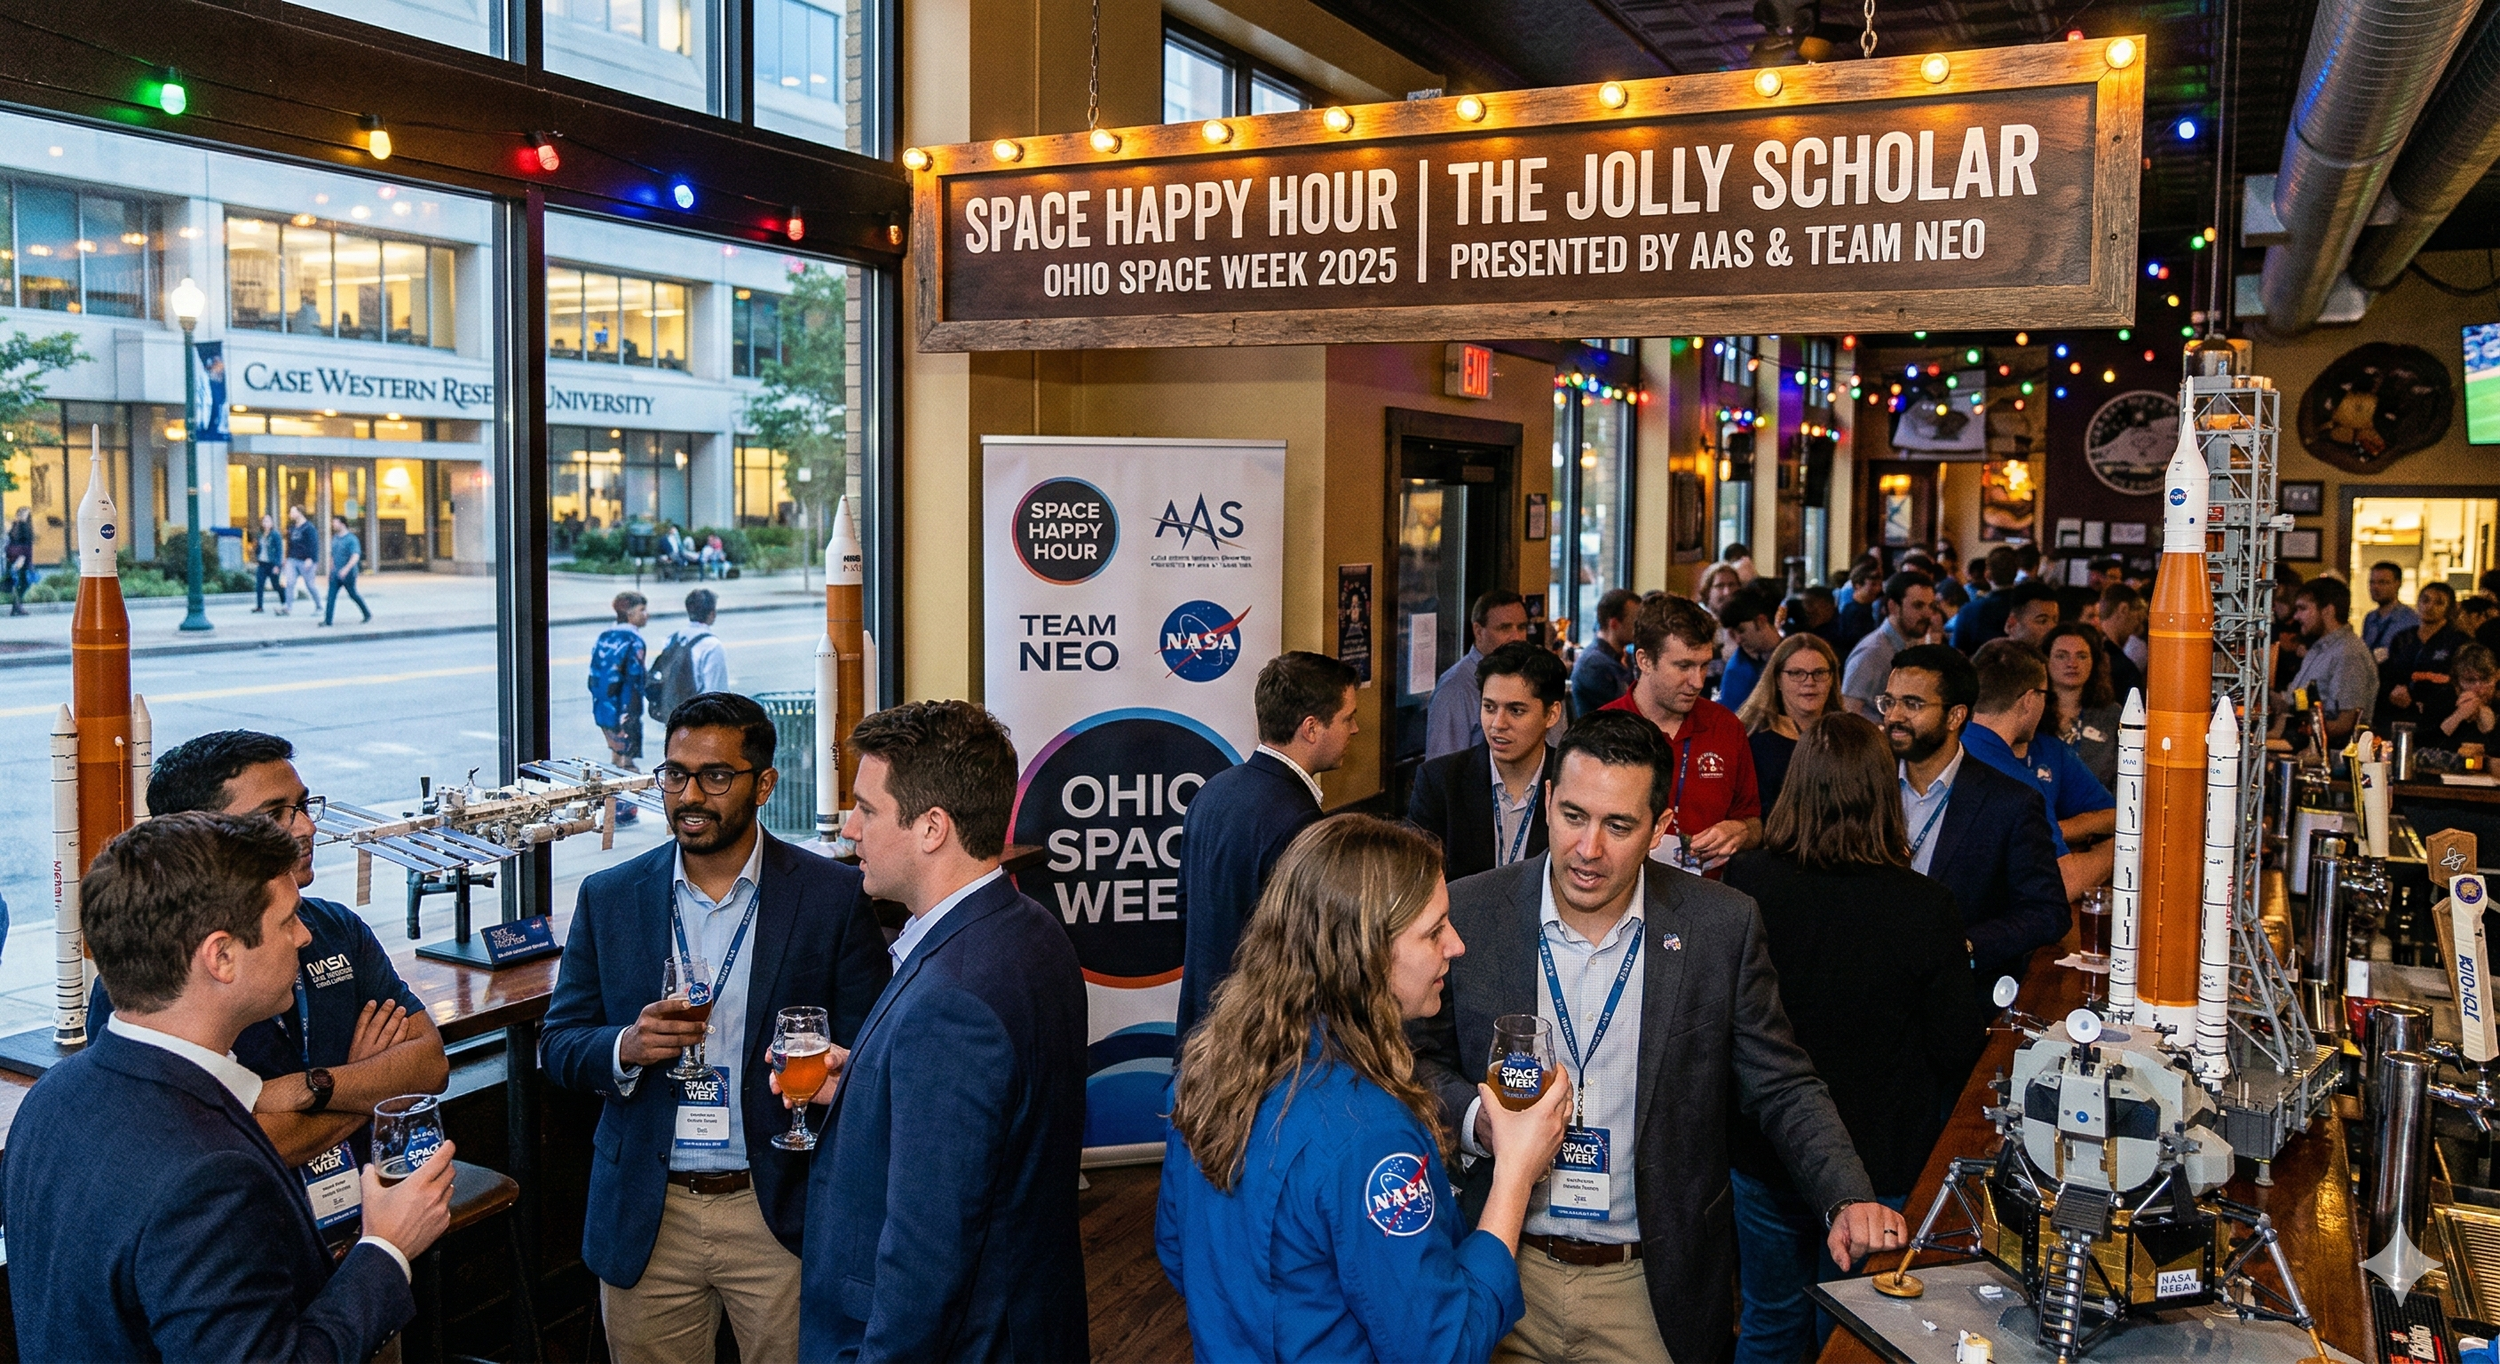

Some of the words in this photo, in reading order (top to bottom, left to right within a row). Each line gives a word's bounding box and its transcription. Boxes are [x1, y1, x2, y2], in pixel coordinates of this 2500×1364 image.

[1447, 157, 1547, 225] THE
[1567, 144, 1733, 220] JOLLY
[1751, 123, 2039, 211] SCHOLAR
[965, 190, 1091, 254] SPACE
[1107, 178, 1253, 246] HAPPY
[1269, 168, 1398, 237] HOUR
[1451, 235, 1628, 280] PRESENTED
[1639, 232, 1681, 273] BY
[1690, 229, 1755, 270] AAS
[1766, 228, 1793, 267] &
[1805, 222, 1901, 265] TEAM
[1914, 218, 1986, 261] NEO
[1044, 262, 1109, 297] OHIO
[1119, 256, 1211, 294] SPACE
[1220, 251, 1308, 289] WEEK
[1318, 247, 1397, 286] 2025
[443, 377, 494, 408] RESE
[1030, 502, 1100, 519] SPACE
[1154, 491, 1244, 551] AAS
[1028, 522, 1103, 539] HAPPY
[1034, 543, 1098, 560] HOUR
[1019, 614, 1116, 636] TEAM
[1166, 632, 1236, 651] NASA
[1019, 640, 1120, 672] NEO
[1047, 825, 1184, 873] SPAC
[1053, 878, 1178, 924] WEE
[306, 953, 350, 977] NASA
[1501, 1067, 1539, 1079] SPACE
[1504, 1076, 1537, 1088] WEEK
[684, 1081, 719, 1091] SPACE
[686, 1090, 718, 1101] WEEK
[1562, 1142, 1599, 1155] SPACE
[1563, 1152, 1598, 1166] WEEK
[1372, 1178, 1429, 1212] NASA
[2162, 1273, 2192, 1285] NASA
